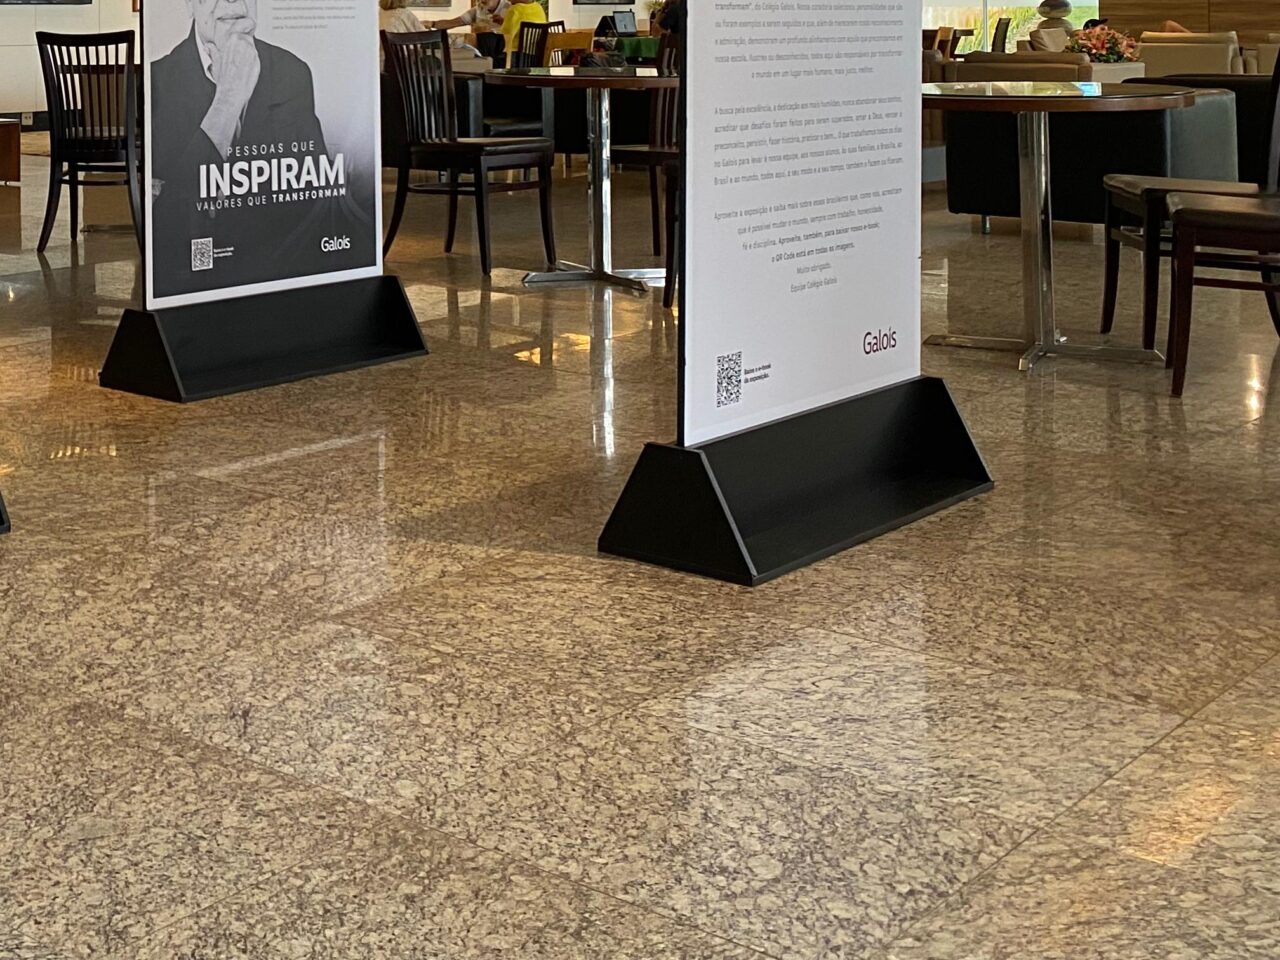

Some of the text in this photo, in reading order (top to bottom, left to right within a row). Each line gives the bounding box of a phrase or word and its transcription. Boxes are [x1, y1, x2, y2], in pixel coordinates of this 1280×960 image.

[227, 140, 315, 157] PESSOAS QUE
[199, 153, 345, 199] INSPIRAM
[196, 187, 346, 211] VALORES QUE TRANSFORMAM
